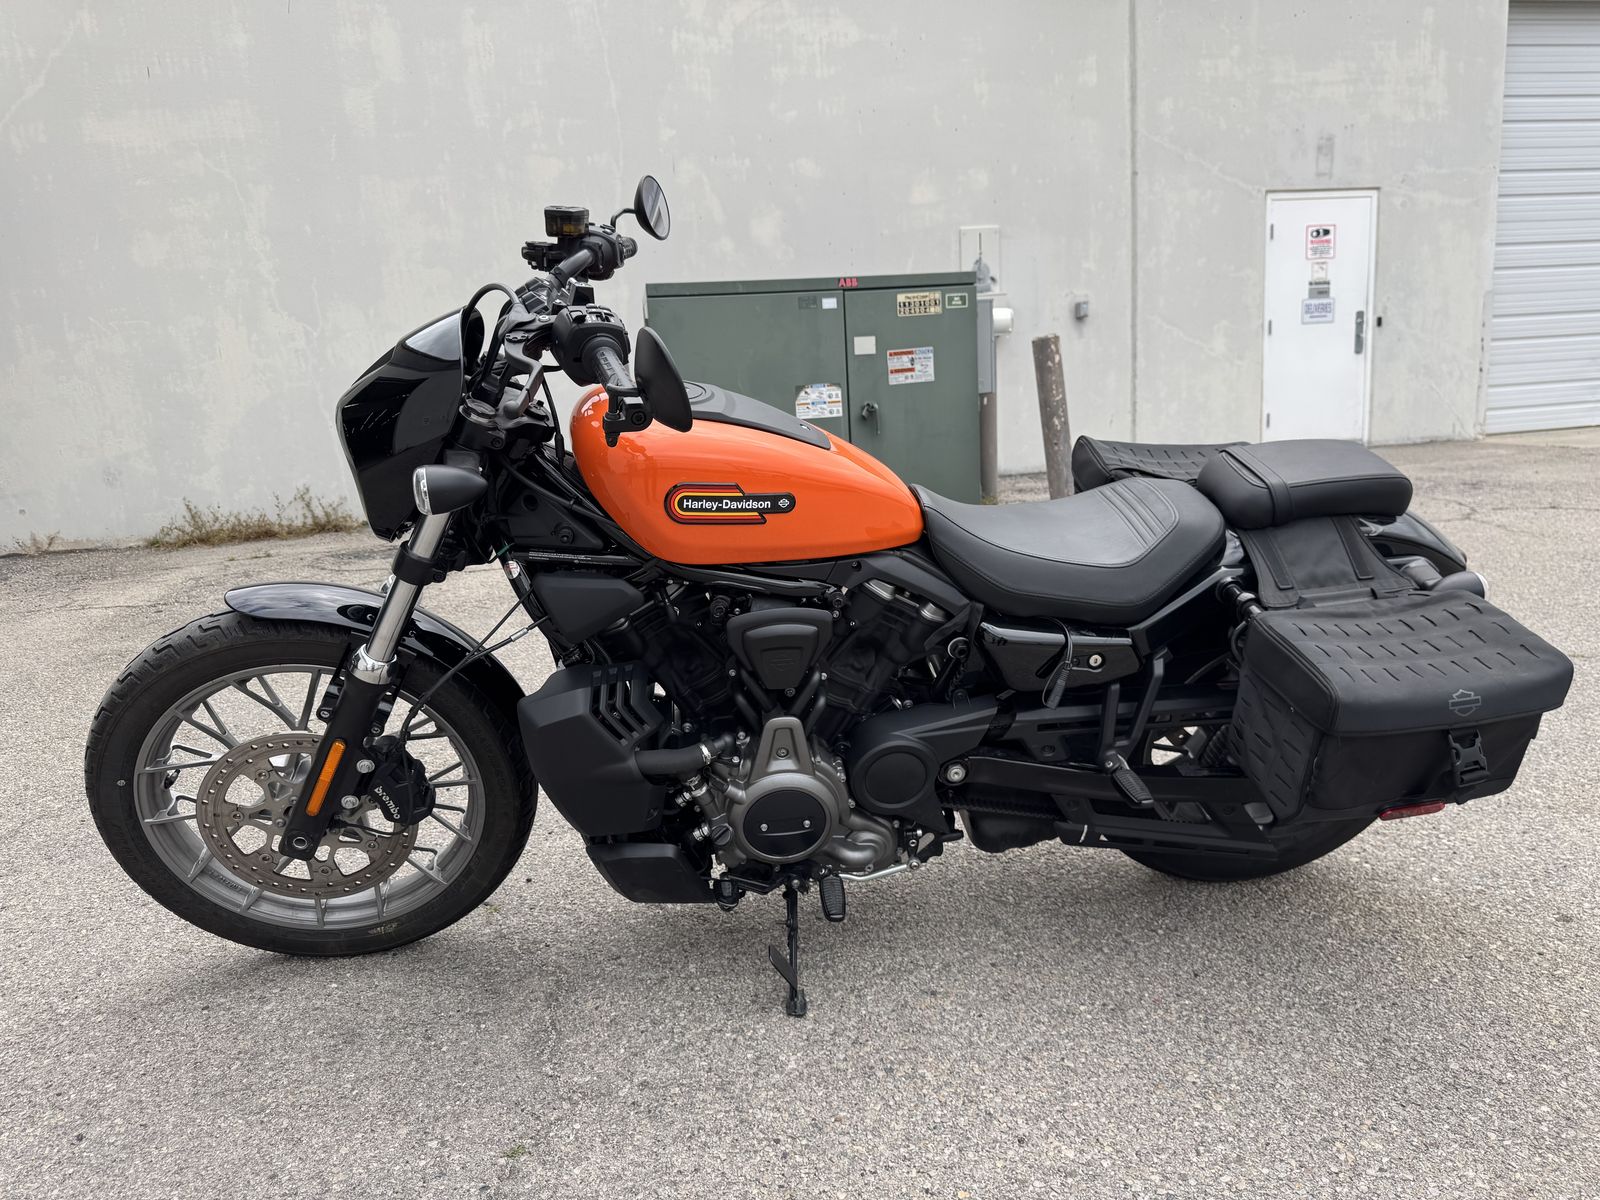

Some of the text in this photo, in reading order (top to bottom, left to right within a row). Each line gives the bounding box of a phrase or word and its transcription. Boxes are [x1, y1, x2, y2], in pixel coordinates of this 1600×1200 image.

[838, 277, 858, 288] ABB
[683, 498, 771, 511] Harley-Davidson
[374, 785, 401, 819] brembo
